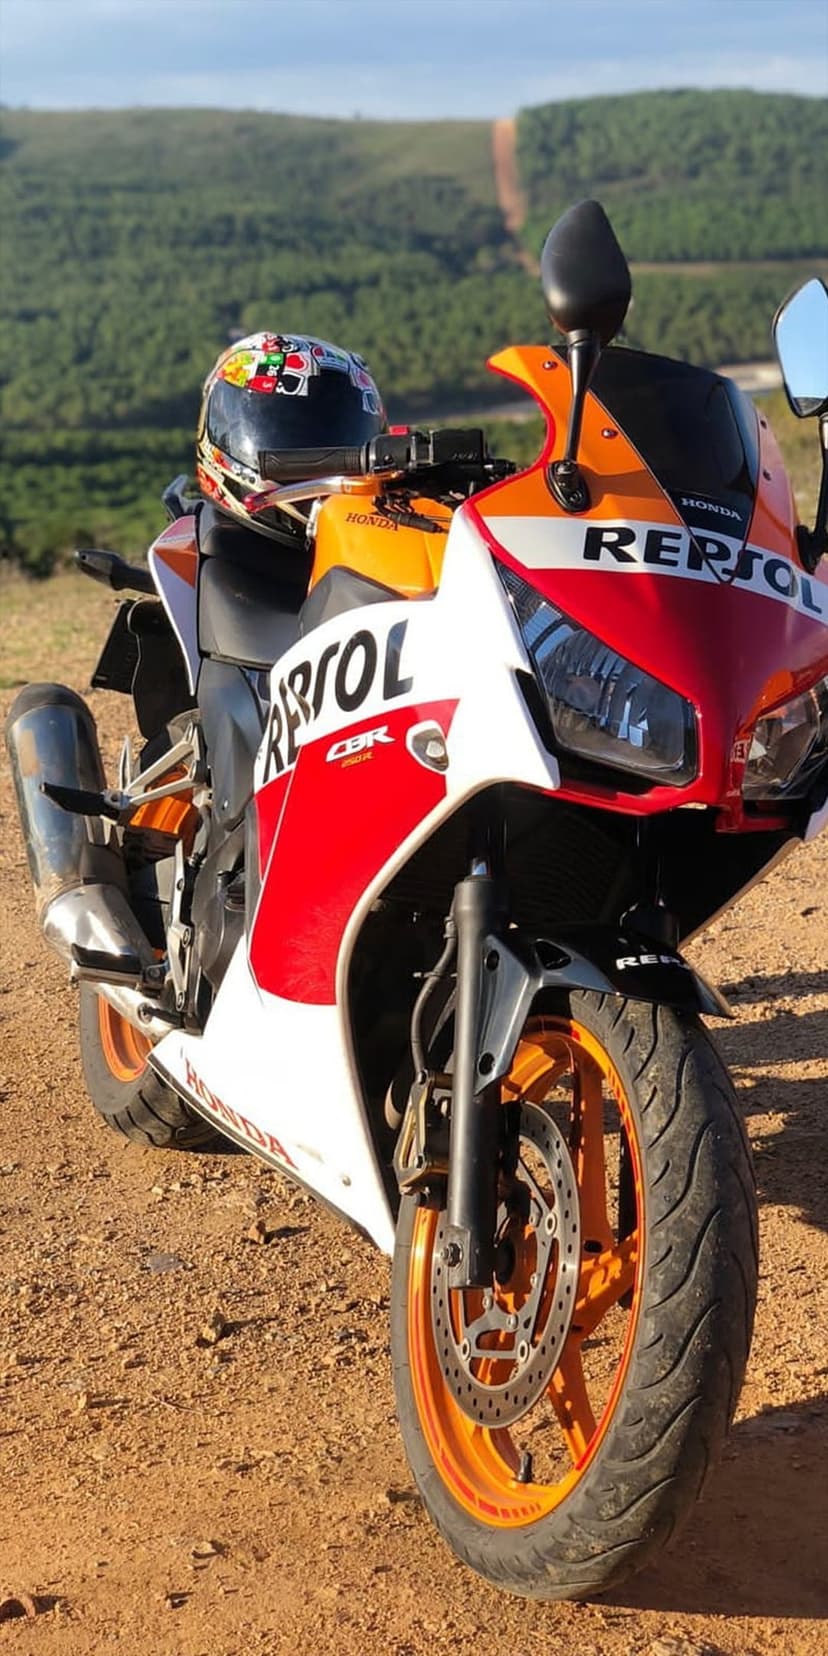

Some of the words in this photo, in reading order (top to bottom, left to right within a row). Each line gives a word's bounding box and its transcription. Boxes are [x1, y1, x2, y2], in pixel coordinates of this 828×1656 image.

[345, 512, 399, 531] HONDA
[681, 498, 743, 521] HONDA
[583, 526, 822, 614] REPSOL
[263, 619, 414, 784] REPSOL
[325, 725, 396, 763] CBR
[185, 1057, 298, 1169] HONDA
